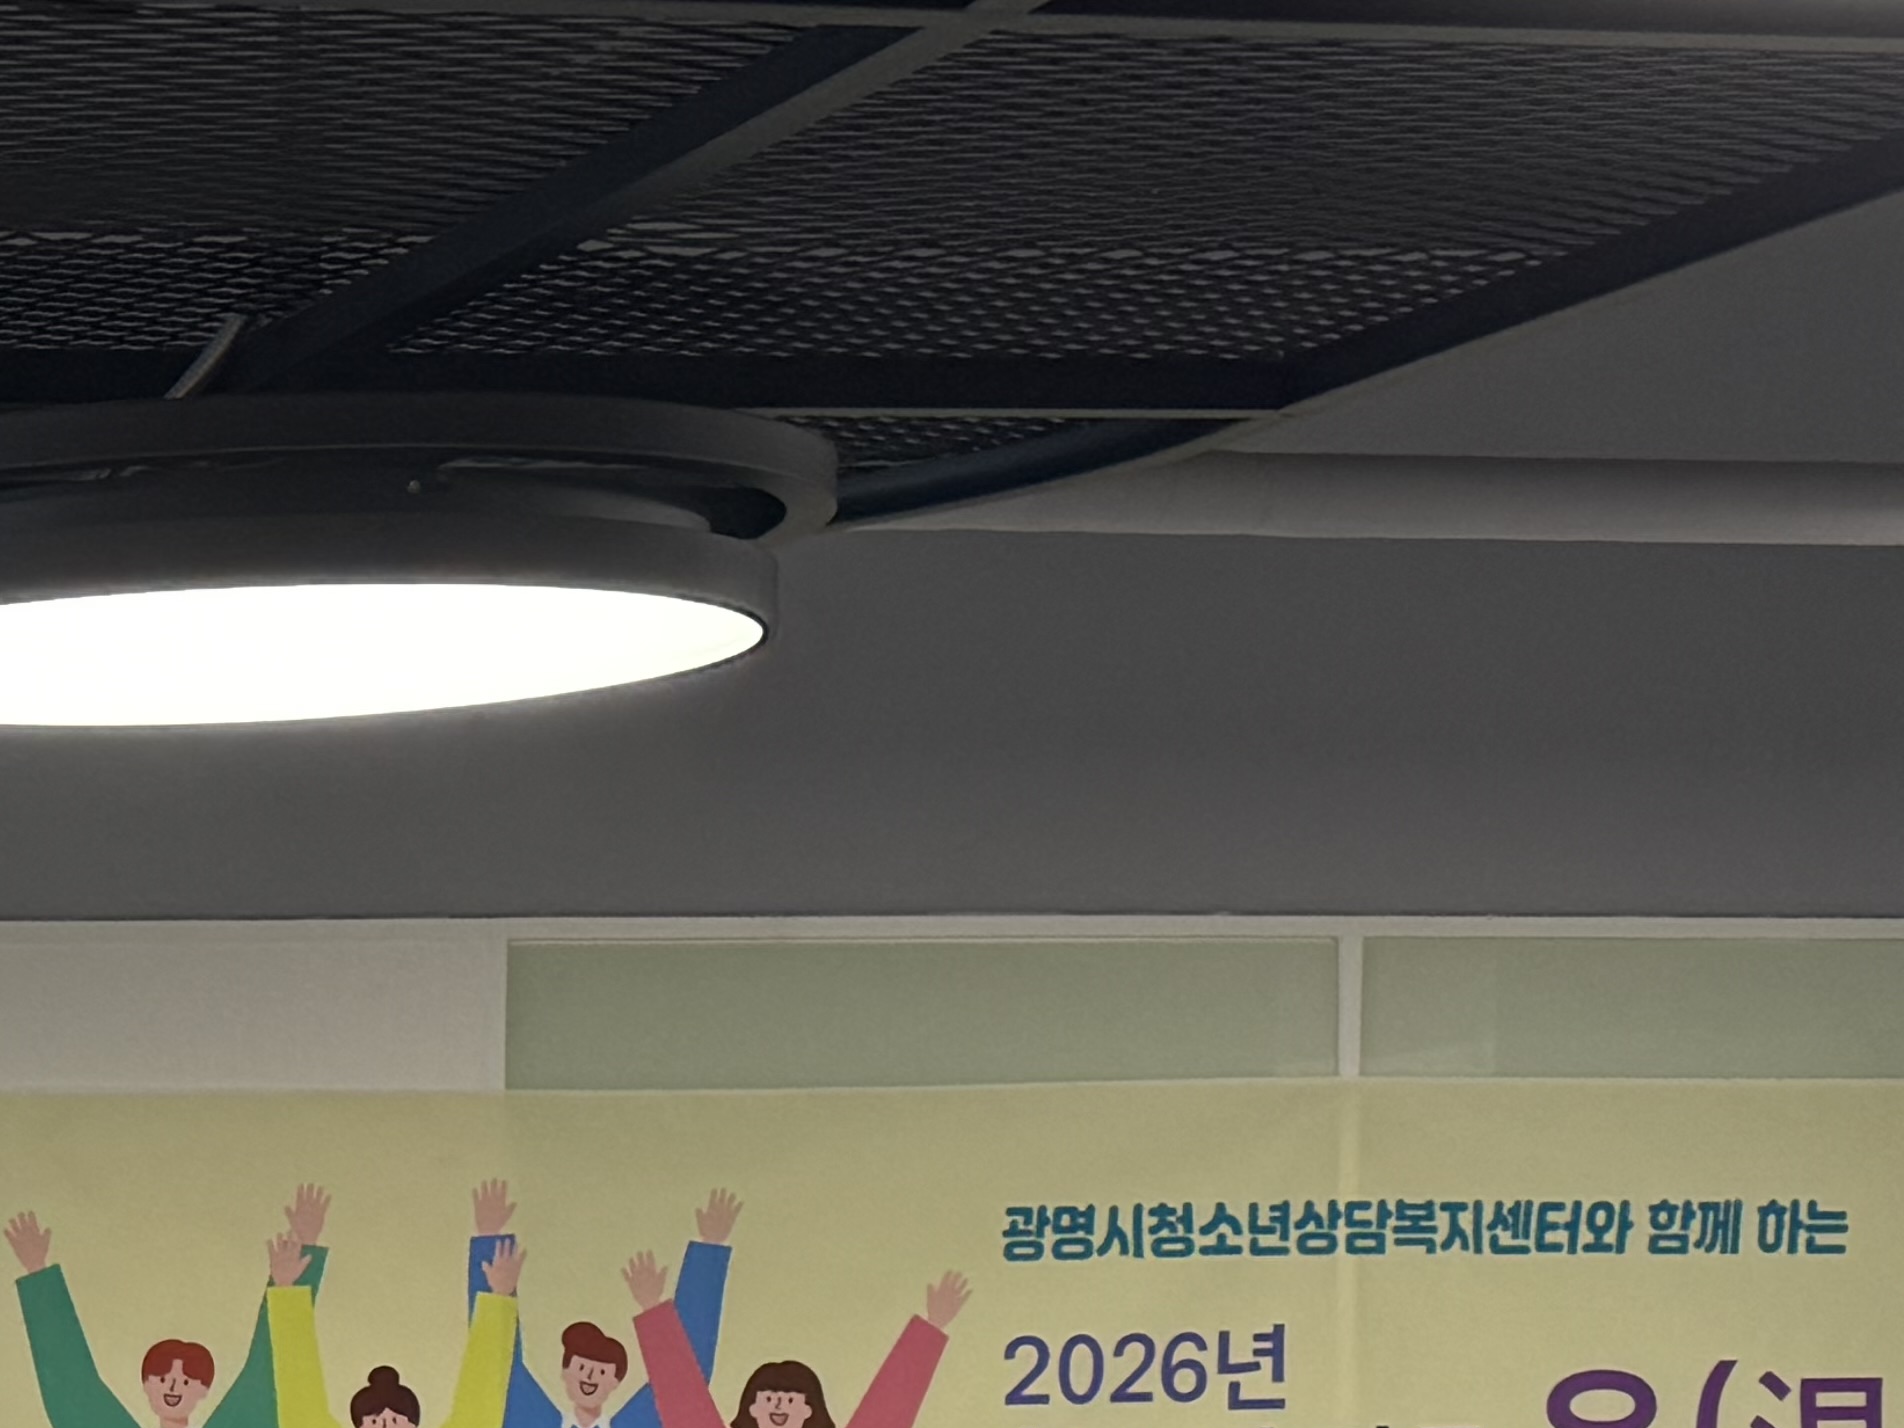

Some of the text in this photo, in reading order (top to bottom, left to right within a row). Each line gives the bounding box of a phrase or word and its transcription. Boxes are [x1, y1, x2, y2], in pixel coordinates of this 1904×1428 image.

[1001, 1196, 1849, 1262] 광명시청소년상담복지센터와 함께 하는
[1002, 1322, 1287, 1411] 2026년
